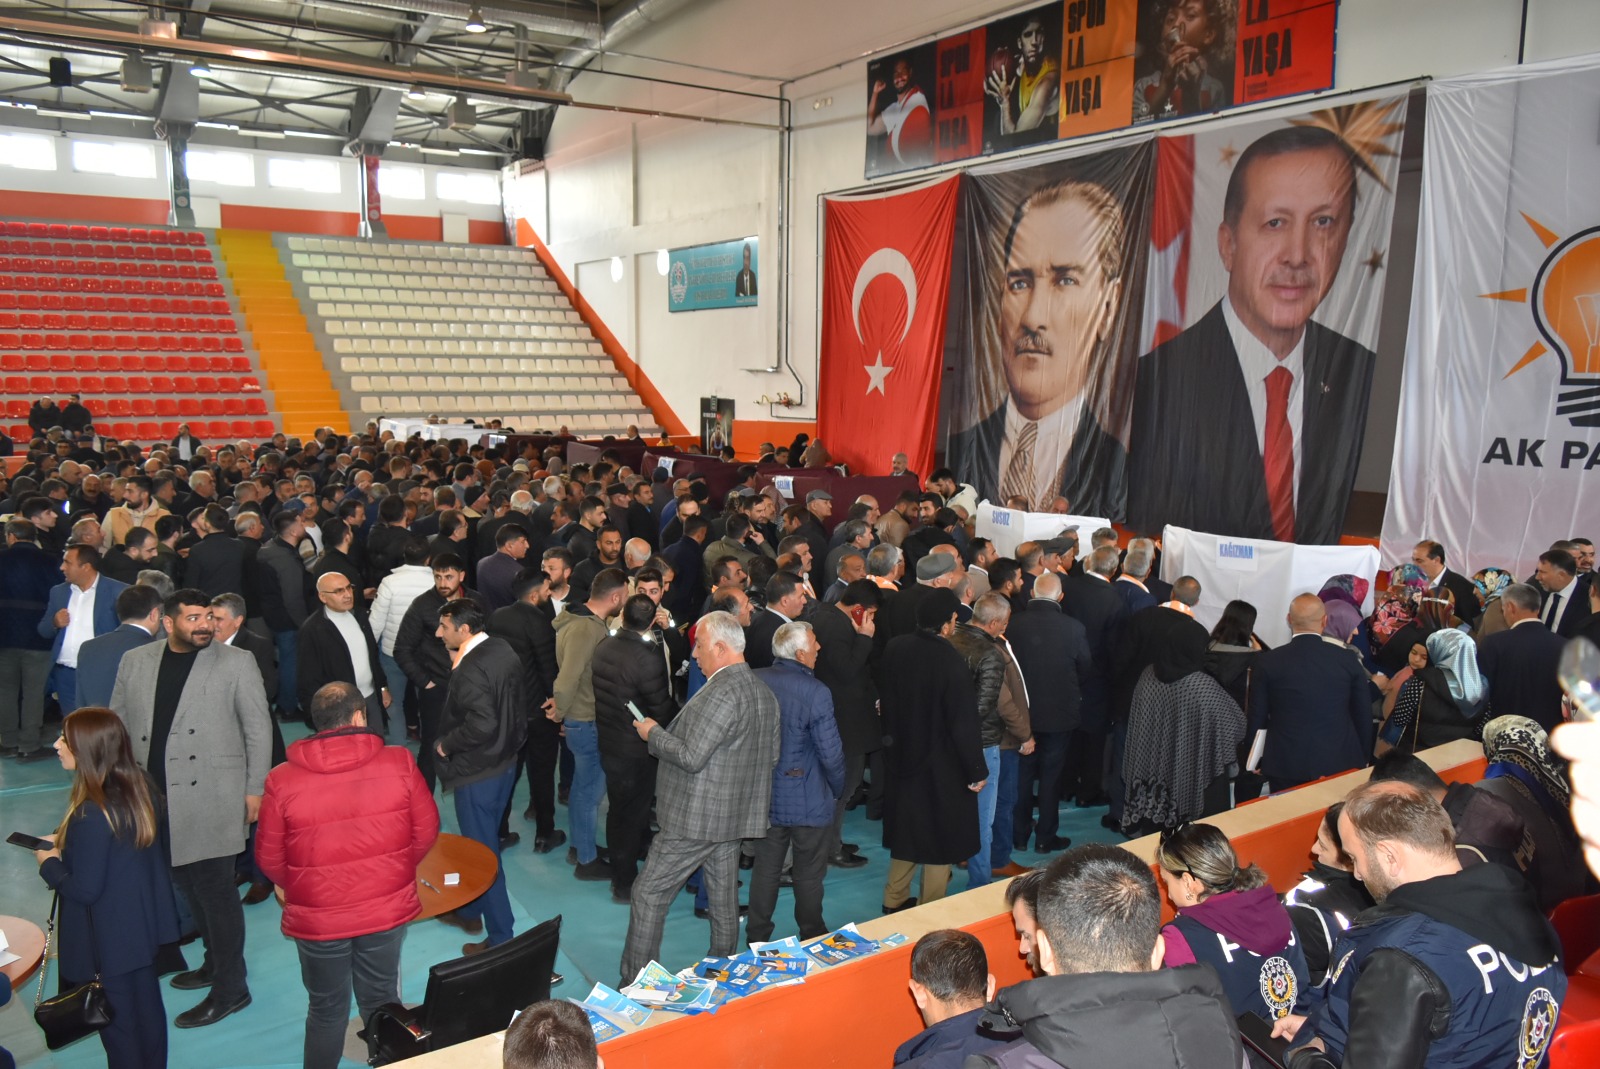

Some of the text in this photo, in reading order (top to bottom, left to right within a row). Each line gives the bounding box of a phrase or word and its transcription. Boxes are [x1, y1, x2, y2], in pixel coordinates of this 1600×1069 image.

[1066, 36, 1085, 71] LA
[1243, 28, 1293, 77] YAŞA
[1065, 75, 1102, 116] YAŞA
[1482, 437, 1546, 467] AK
